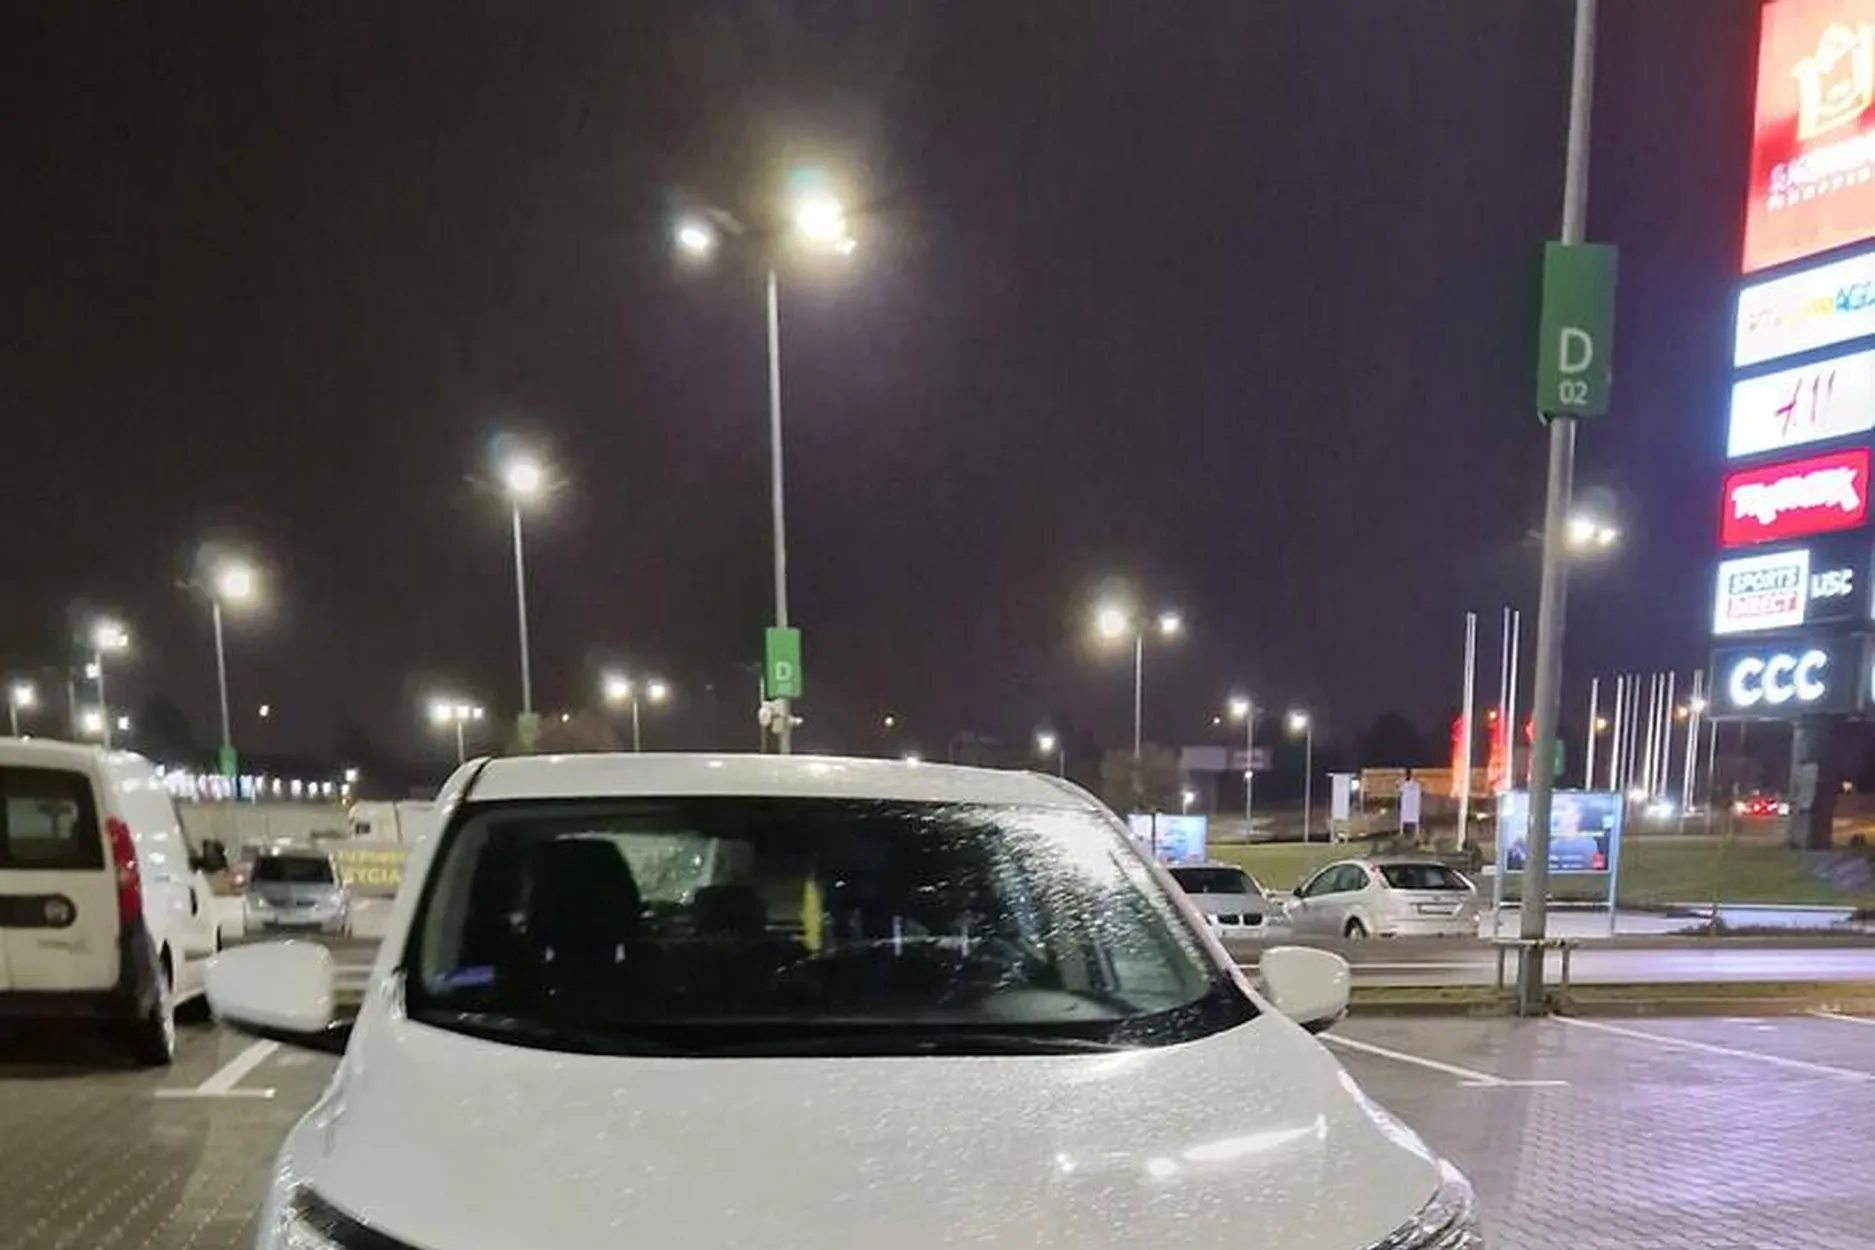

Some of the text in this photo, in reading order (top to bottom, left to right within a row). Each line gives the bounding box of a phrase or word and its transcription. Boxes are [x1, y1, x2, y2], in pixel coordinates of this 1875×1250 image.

[1558, 327, 1594, 374] D
[1558, 379, 1590, 406] 02
[1811, 568, 1854, 599] USC
[775, 660, 793, 681] D
[1729, 649, 1828, 706] CCC
